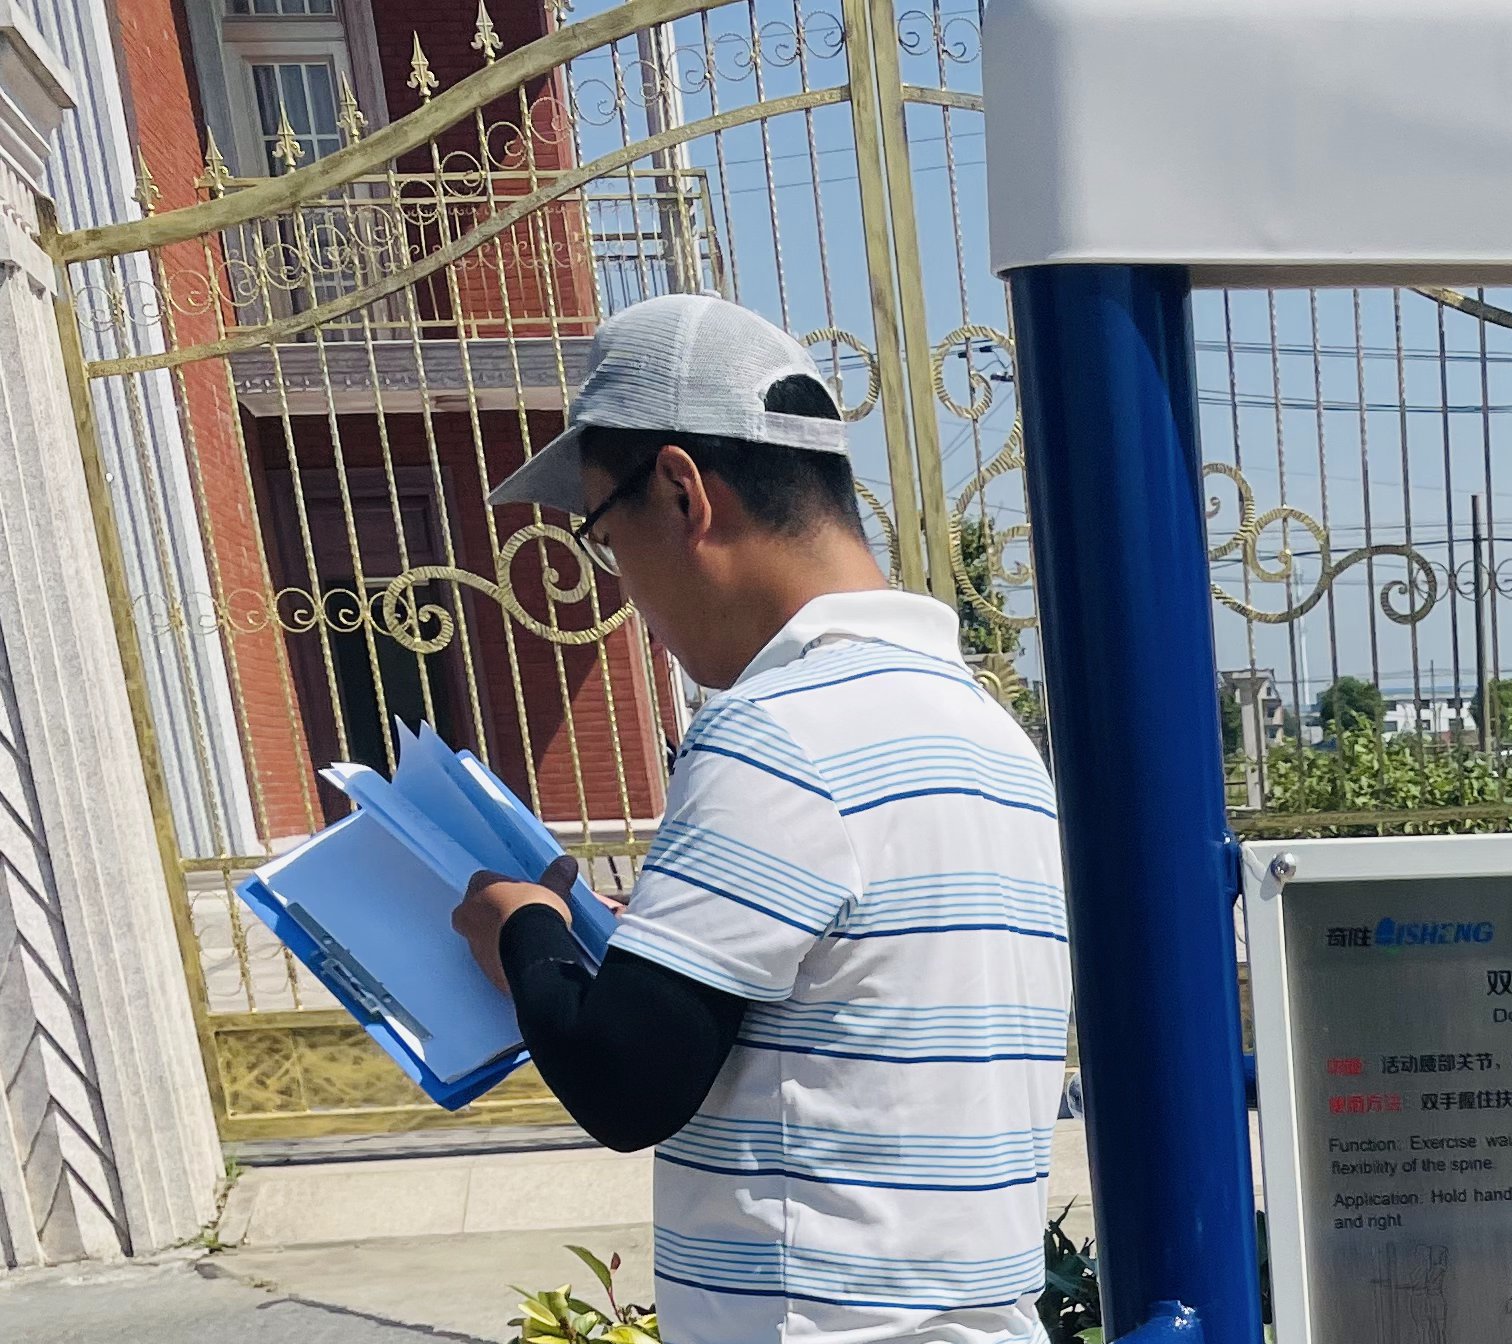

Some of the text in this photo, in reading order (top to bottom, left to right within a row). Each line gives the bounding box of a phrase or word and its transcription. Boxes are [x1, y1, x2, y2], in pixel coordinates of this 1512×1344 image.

[1409, 1135, 1477, 1151] Exercise
[1401, 1157, 1419, 1173] of
[1421, 1158, 1447, 1173] the
[1430, 1188, 1467, 1205] Hold
[1333, 1213, 1364, 1230] and
